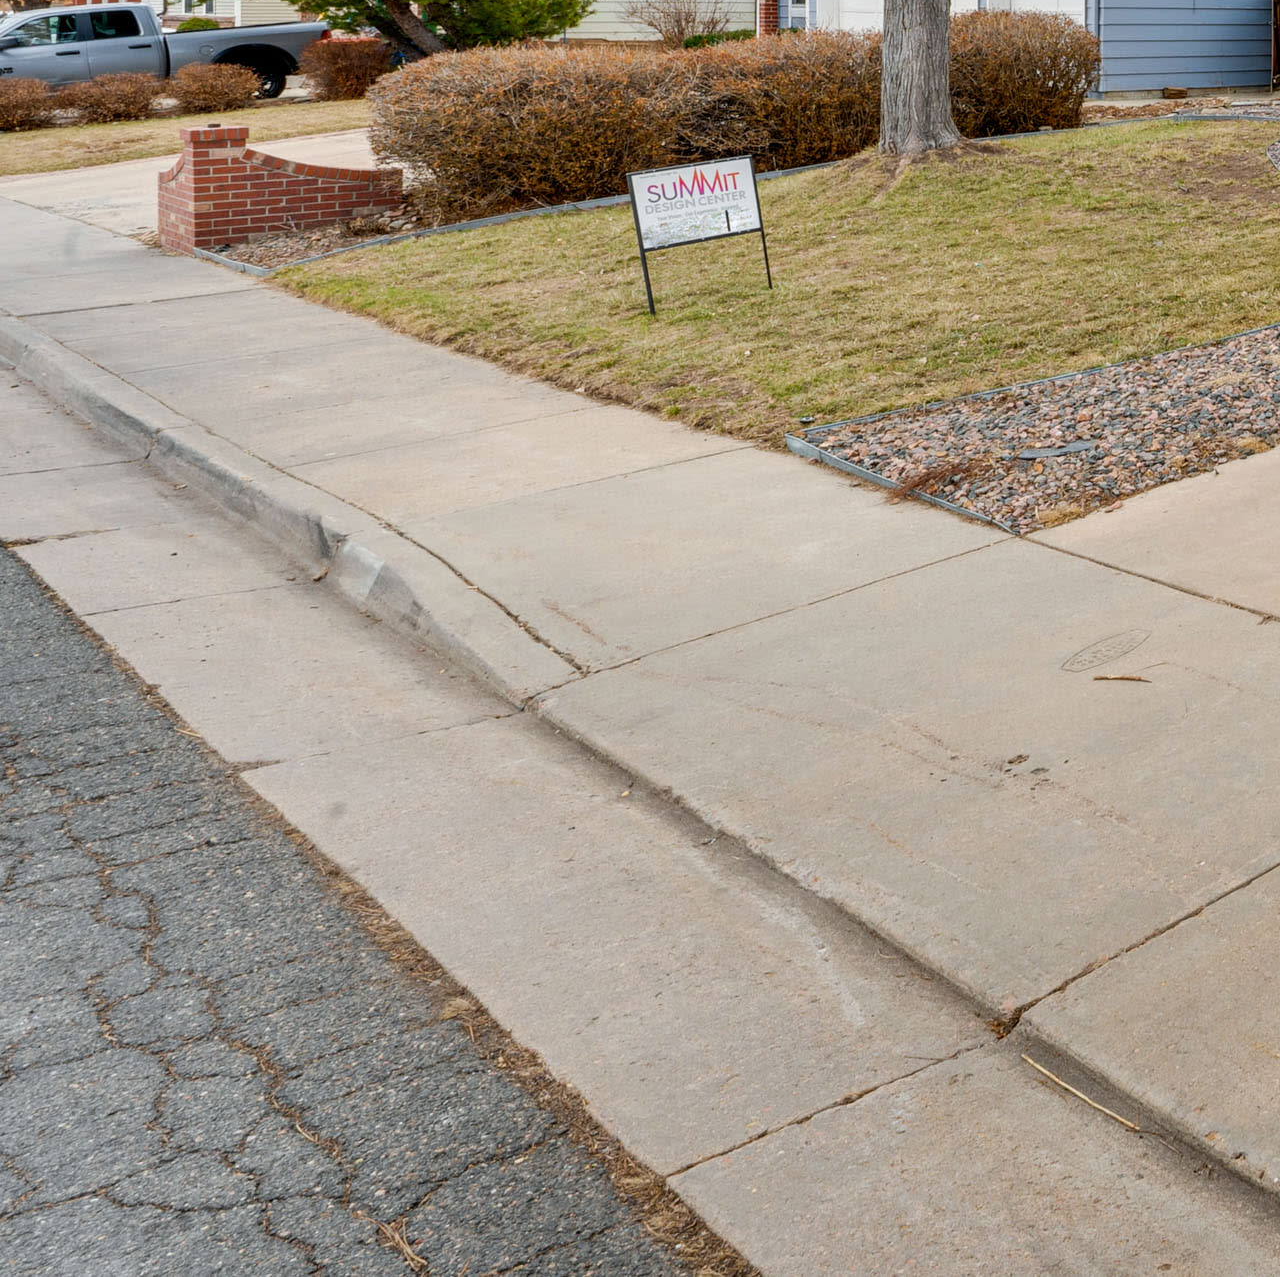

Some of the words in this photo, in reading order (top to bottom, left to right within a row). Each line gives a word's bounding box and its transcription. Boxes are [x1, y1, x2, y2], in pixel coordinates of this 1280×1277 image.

[647, 167, 740, 203] SUMMIT
[645, 198, 696, 215] DESIGN
[698, 190, 747, 206] CENTER
